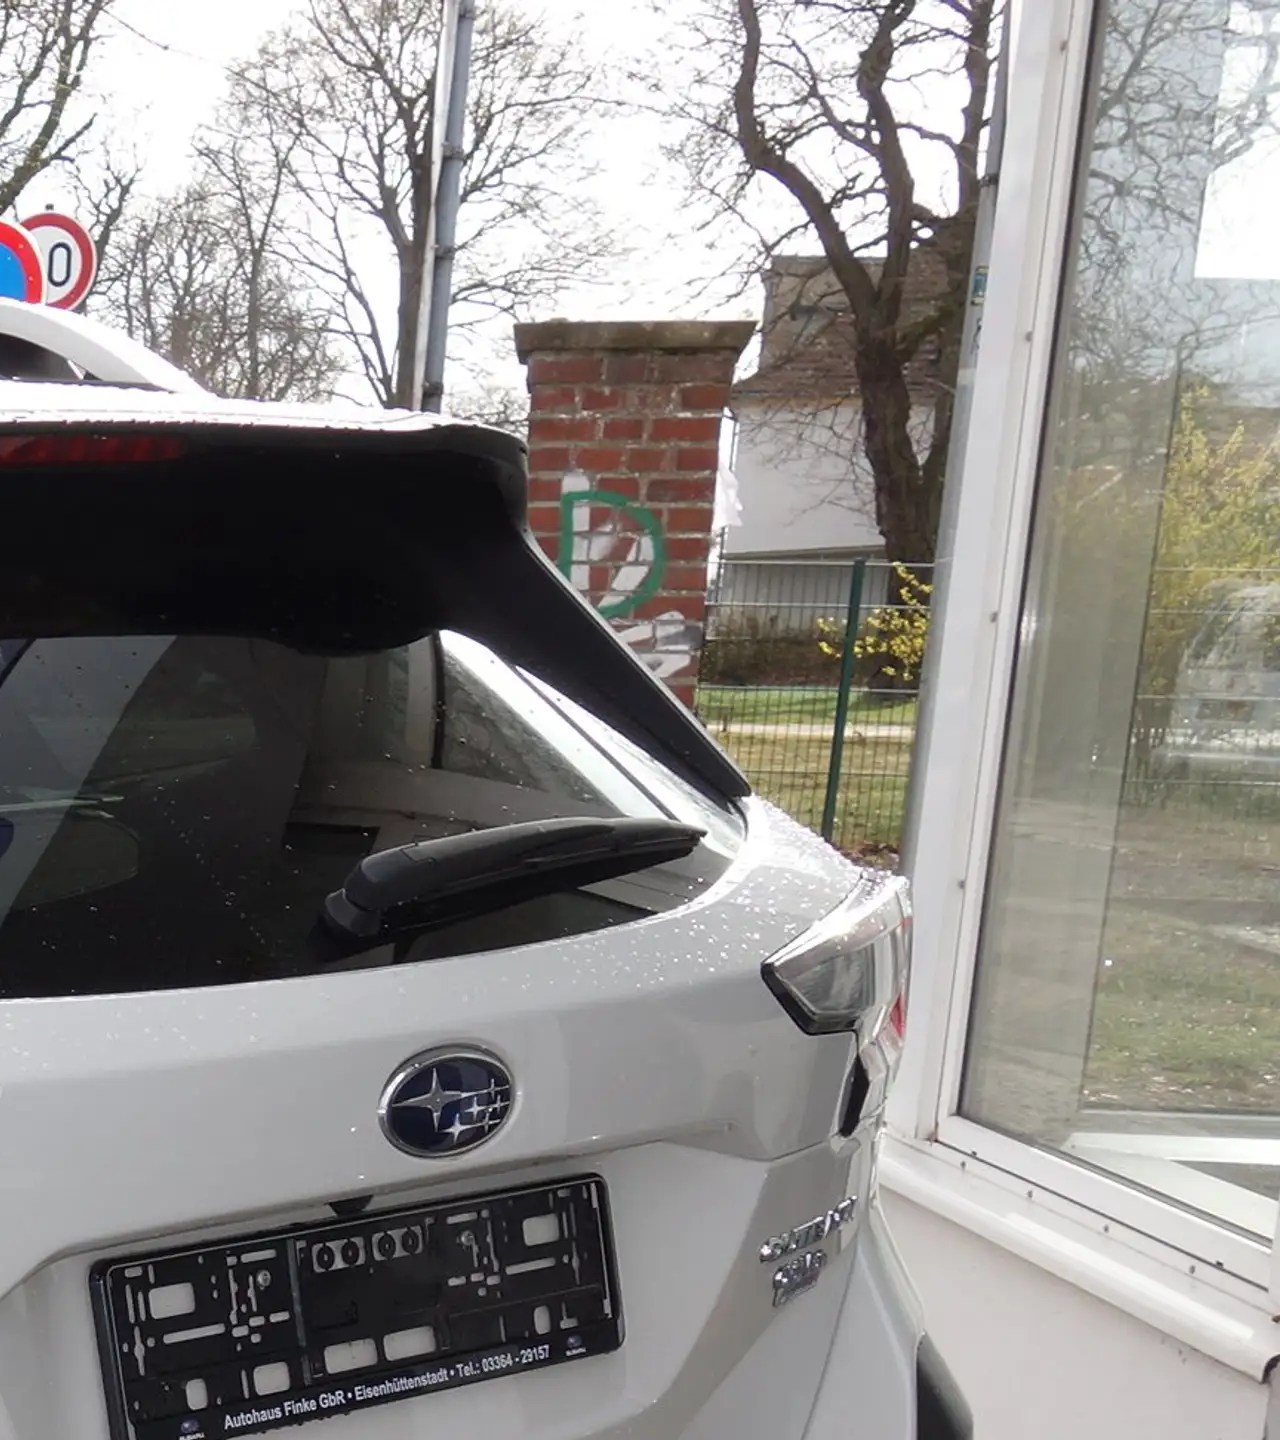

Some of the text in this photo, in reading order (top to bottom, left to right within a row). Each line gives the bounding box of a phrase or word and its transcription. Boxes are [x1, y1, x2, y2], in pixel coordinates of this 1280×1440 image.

[47, 241, 72, 287] 0
[224, 1404, 283, 1430] Autohaus
[284, 1395, 317, 1415] Finke
[319, 1390, 347, 1409] GbR
[354, 1366, 448, 1400] Eisenhüttenstadt
[456, 1362, 480, 1378] Tel.:
[481, 1353, 513, 1373] 03364
[520, 1344, 550, 1363] 29157
